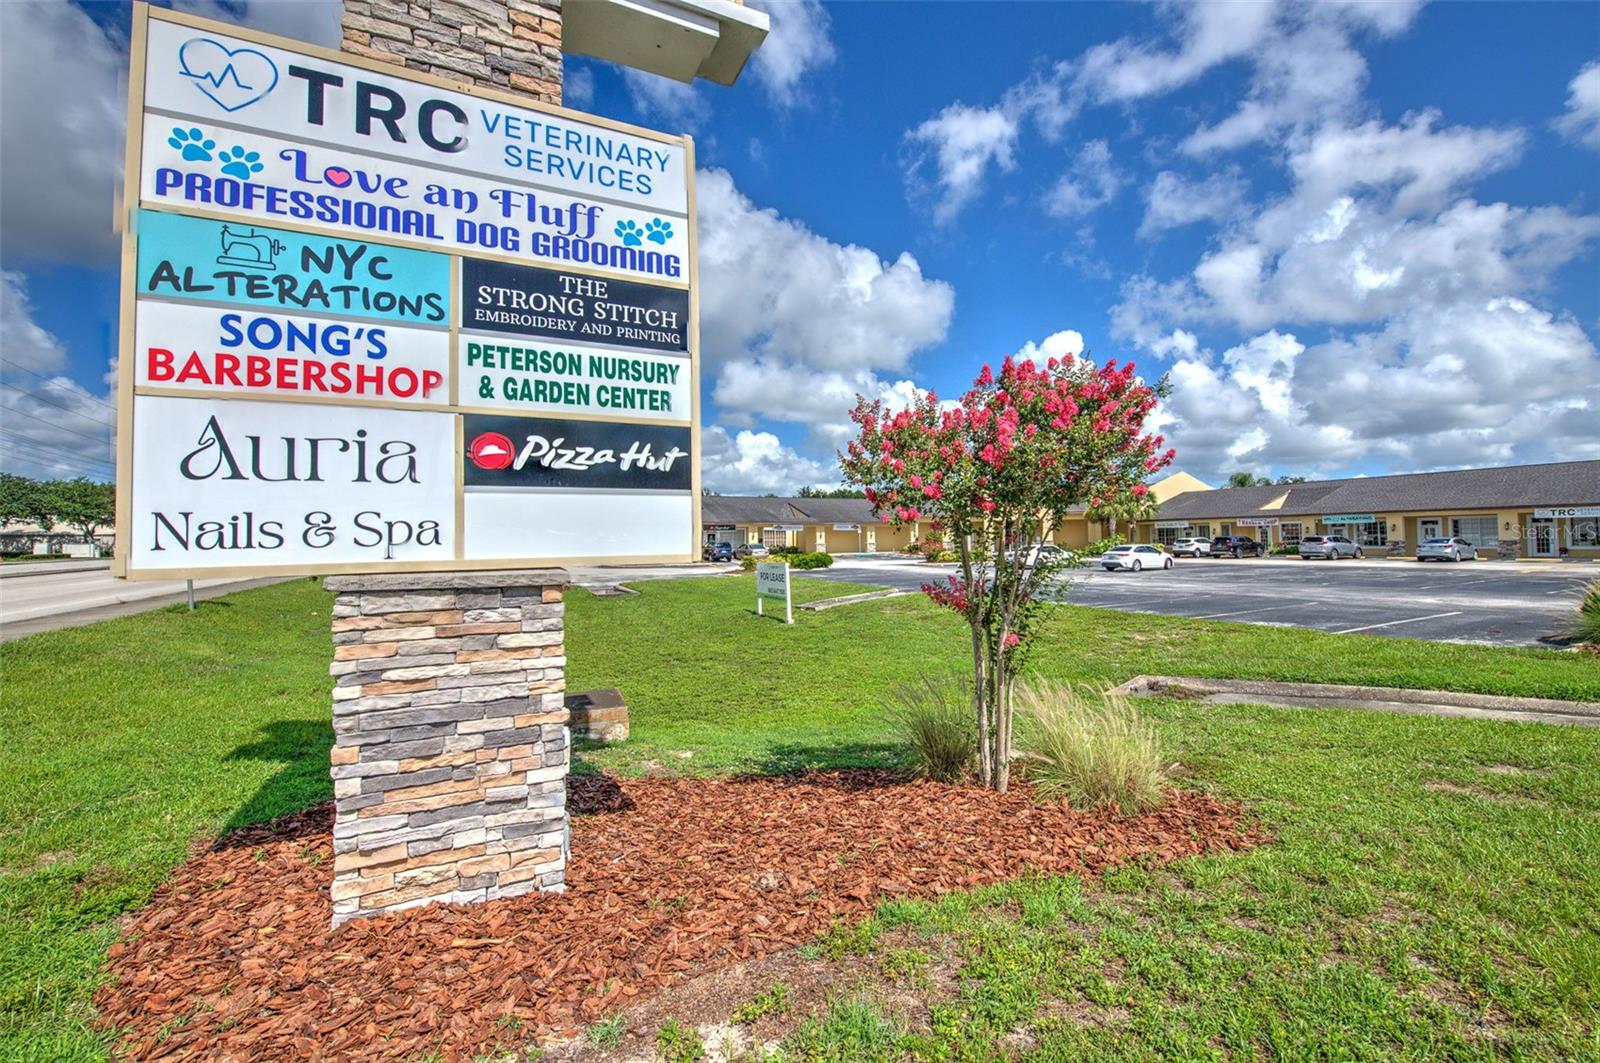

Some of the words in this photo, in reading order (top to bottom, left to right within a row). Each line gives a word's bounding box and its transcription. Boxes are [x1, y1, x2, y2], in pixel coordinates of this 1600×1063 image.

[288, 64, 469, 153] TRC
[480, 109, 671, 173] VETERINARY
[504, 144, 653, 195] SERVICES
[279, 148, 409, 199] Love
[425, 183, 479, 214] an
[489, 188, 604, 240] Fluff
[155, 167, 444, 241] PROFESSIONAL
[456, 219, 520, 253] DOG
[531, 233, 681, 278] GROOMING
[301, 244, 394, 281] NYC
[559, 274, 609, 299] THE
[148, 259, 446, 322] ALTERATIONS
[477, 284, 585, 318] STRONG
[593, 300, 679, 330] STITCH
[219, 313, 389, 361] SONG'S
[474, 309, 577, 332] EMBROIDERY
[580, 320, 613, 335] AND
[616, 325, 681, 345] PRINTING
[147, 346, 444, 399] BARBERSHOP
[466, 342, 583, 377] PETERSON
[587, 355, 680, 386] NURSURY
[478, 375, 495, 399] &
[502, 376, 591, 406] GARDEN
[596, 385, 673, 412] CENTER
[180, 414, 421, 485] Auria
[513, 434, 617, 472] Pizza
[614, 441, 689, 473] Hut
[150, 510, 285, 552] Nails
[302, 511, 338, 549] &
[353, 511, 443, 562] Spa
[1550, 508, 1576, 517] TRC
[760, 571, 770, 581] FOR
[770, 572, 785, 583] LEASE
